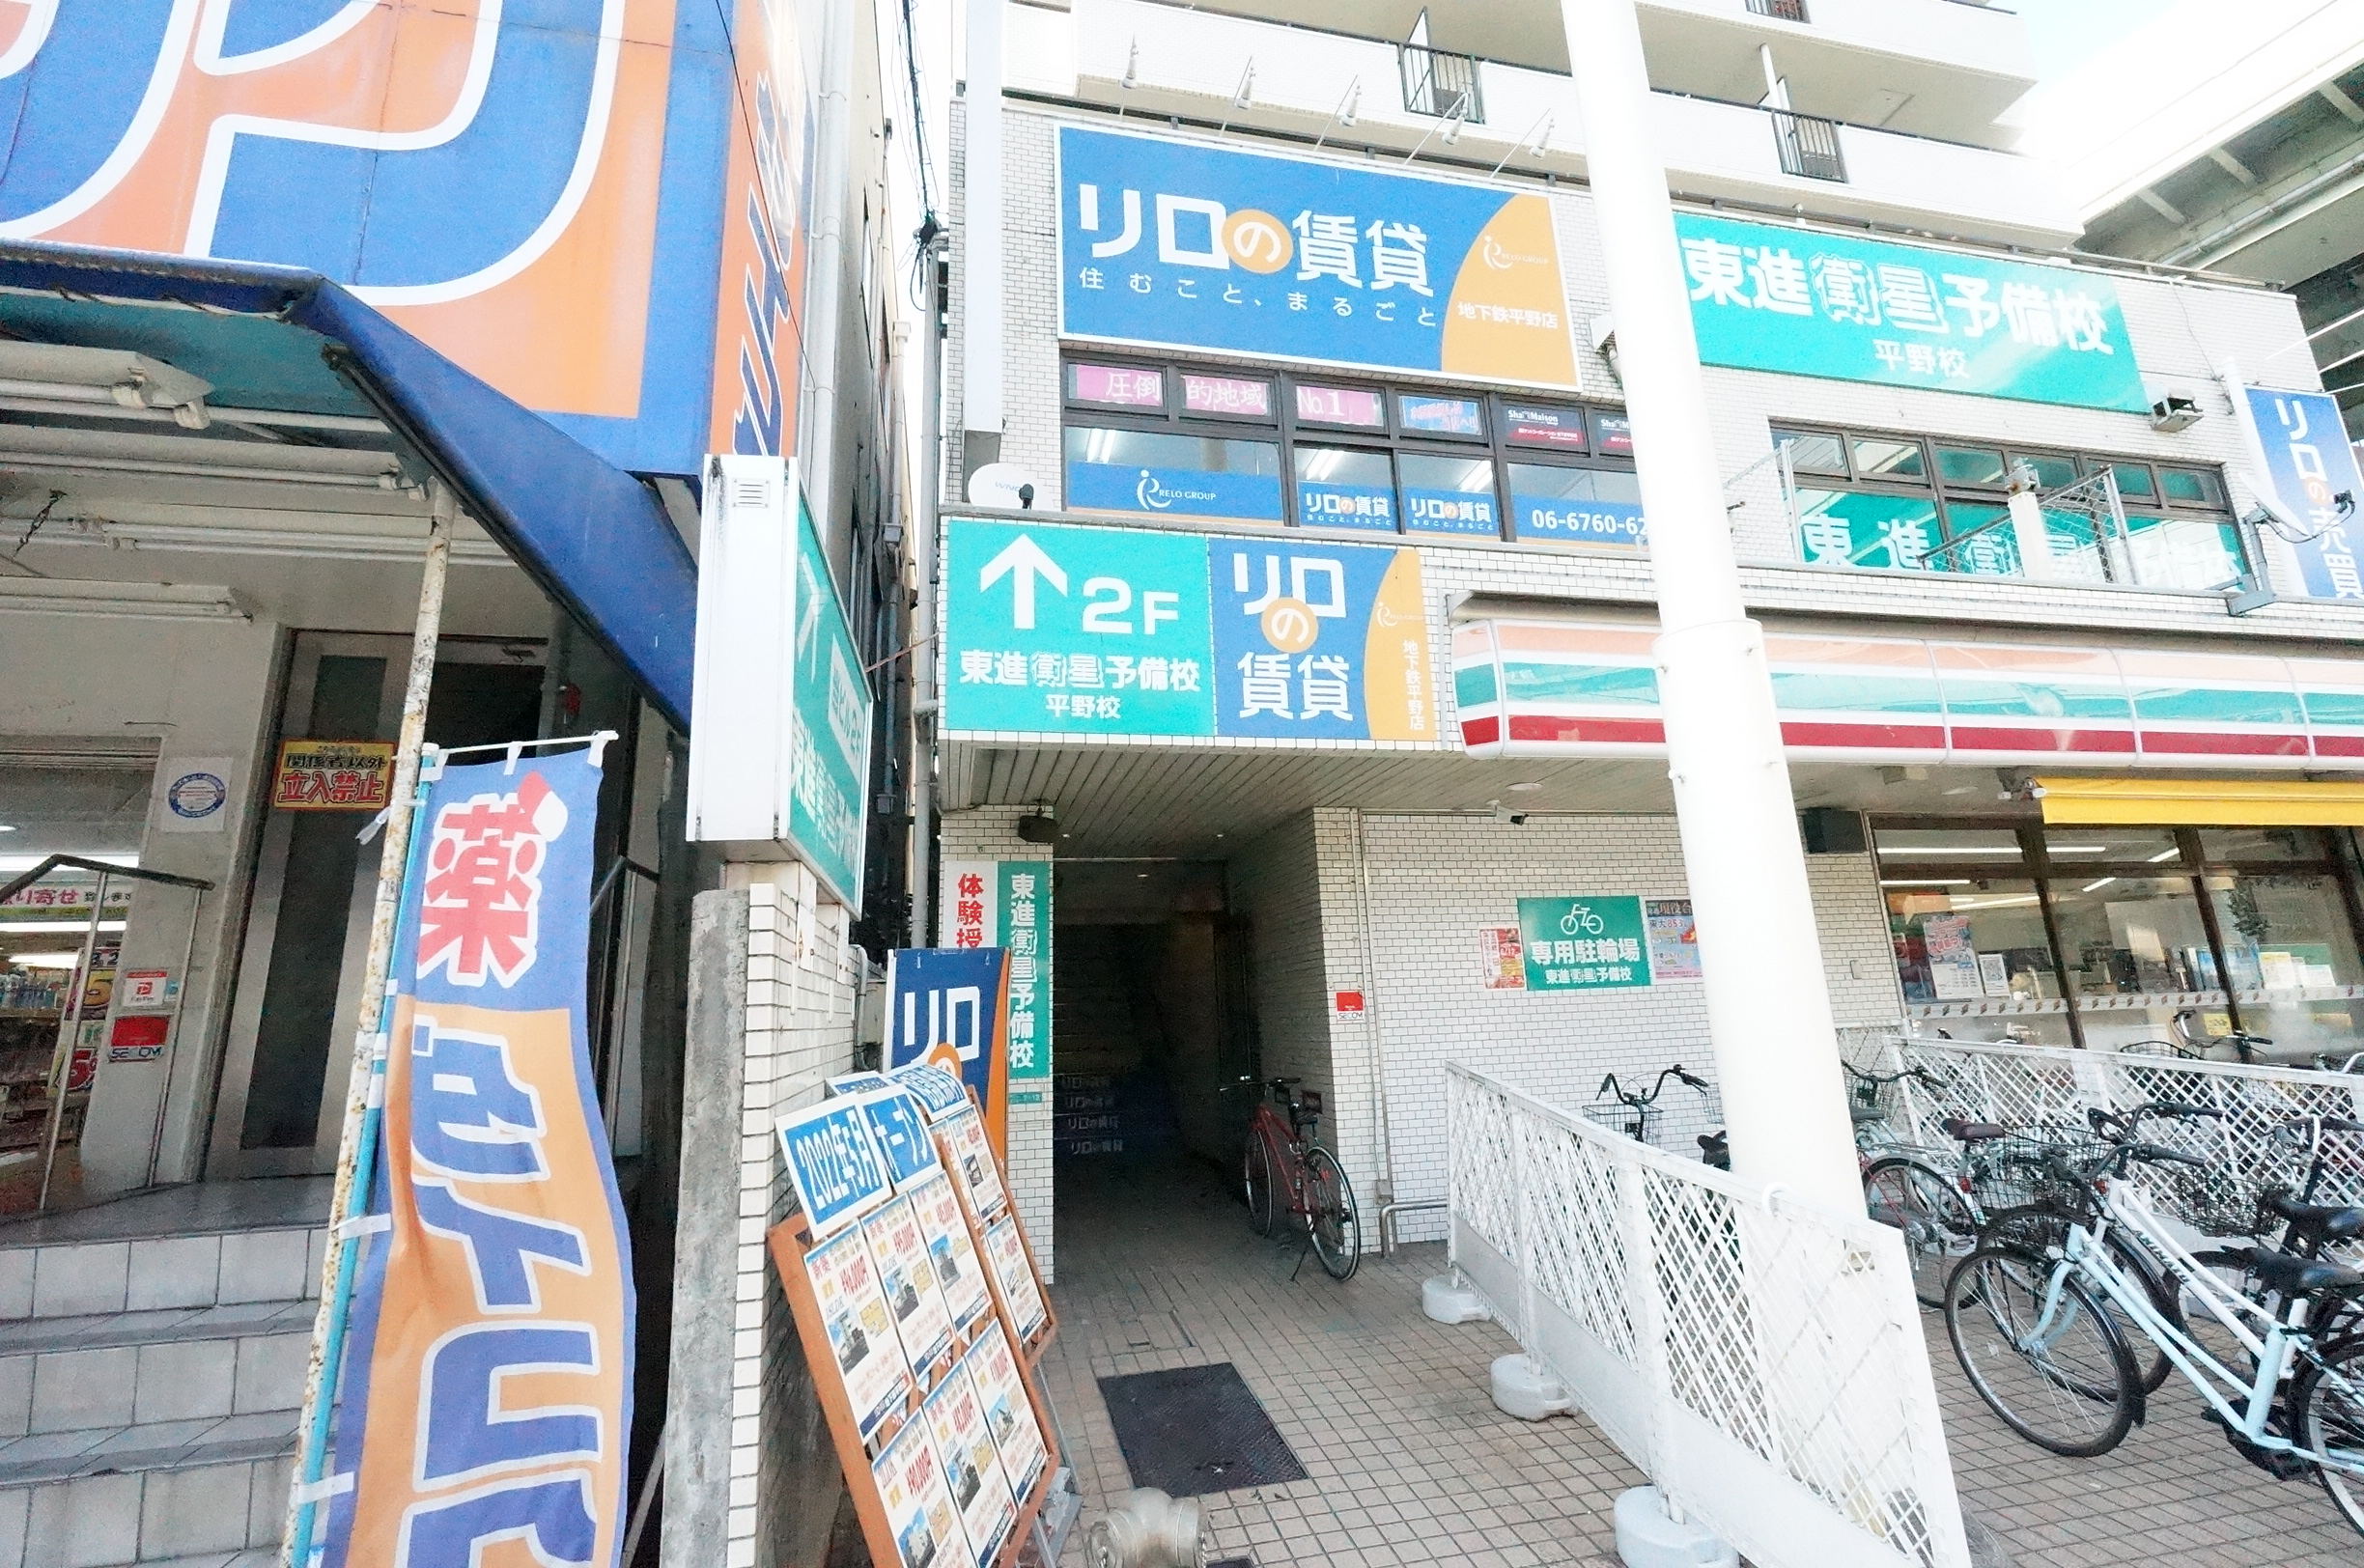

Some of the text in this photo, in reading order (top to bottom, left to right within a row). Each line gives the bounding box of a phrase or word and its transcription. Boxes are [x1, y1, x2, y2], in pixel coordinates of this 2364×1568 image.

[1080, 183, 1434, 297] リロの賃貸
[1080, 266, 1436, 327] 住むこと、まるごと
[1457, 301, 1559, 329] 地下鉄平野店
[1680, 238, 2114, 355] 東進衛星予備校
[1873, 339, 1971, 378] 平野校
[1106, 372, 1163, 402] 圧倒
[1186, 378, 1268, 410] 的地域
[1184, 491, 1217, 501] GROUP
[1306, 492, 1391, 518] リロの賃貸
[1411, 498, 1492, 522] リロの賃貸
[1532, 509, 1647, 536] 06-6760-62
[1083, 577, 1179, 634] 2F
[959, 650, 1201, 692] 東進衛星予備校
[1402, 639, 1424, 731] 地下鉄平野店
[1045, 694, 1121, 719] 平野校
[277, 770, 384, 803] 立入禁止
[1009, 873, 1038, 1069] 東進衛星予備校
[1530, 938, 1641, 966] 専用駐輪場
[1545, 966, 1632, 985] 東進衛星予備校
[795, 1097, 929, 1208] 2022年5月 オープン
